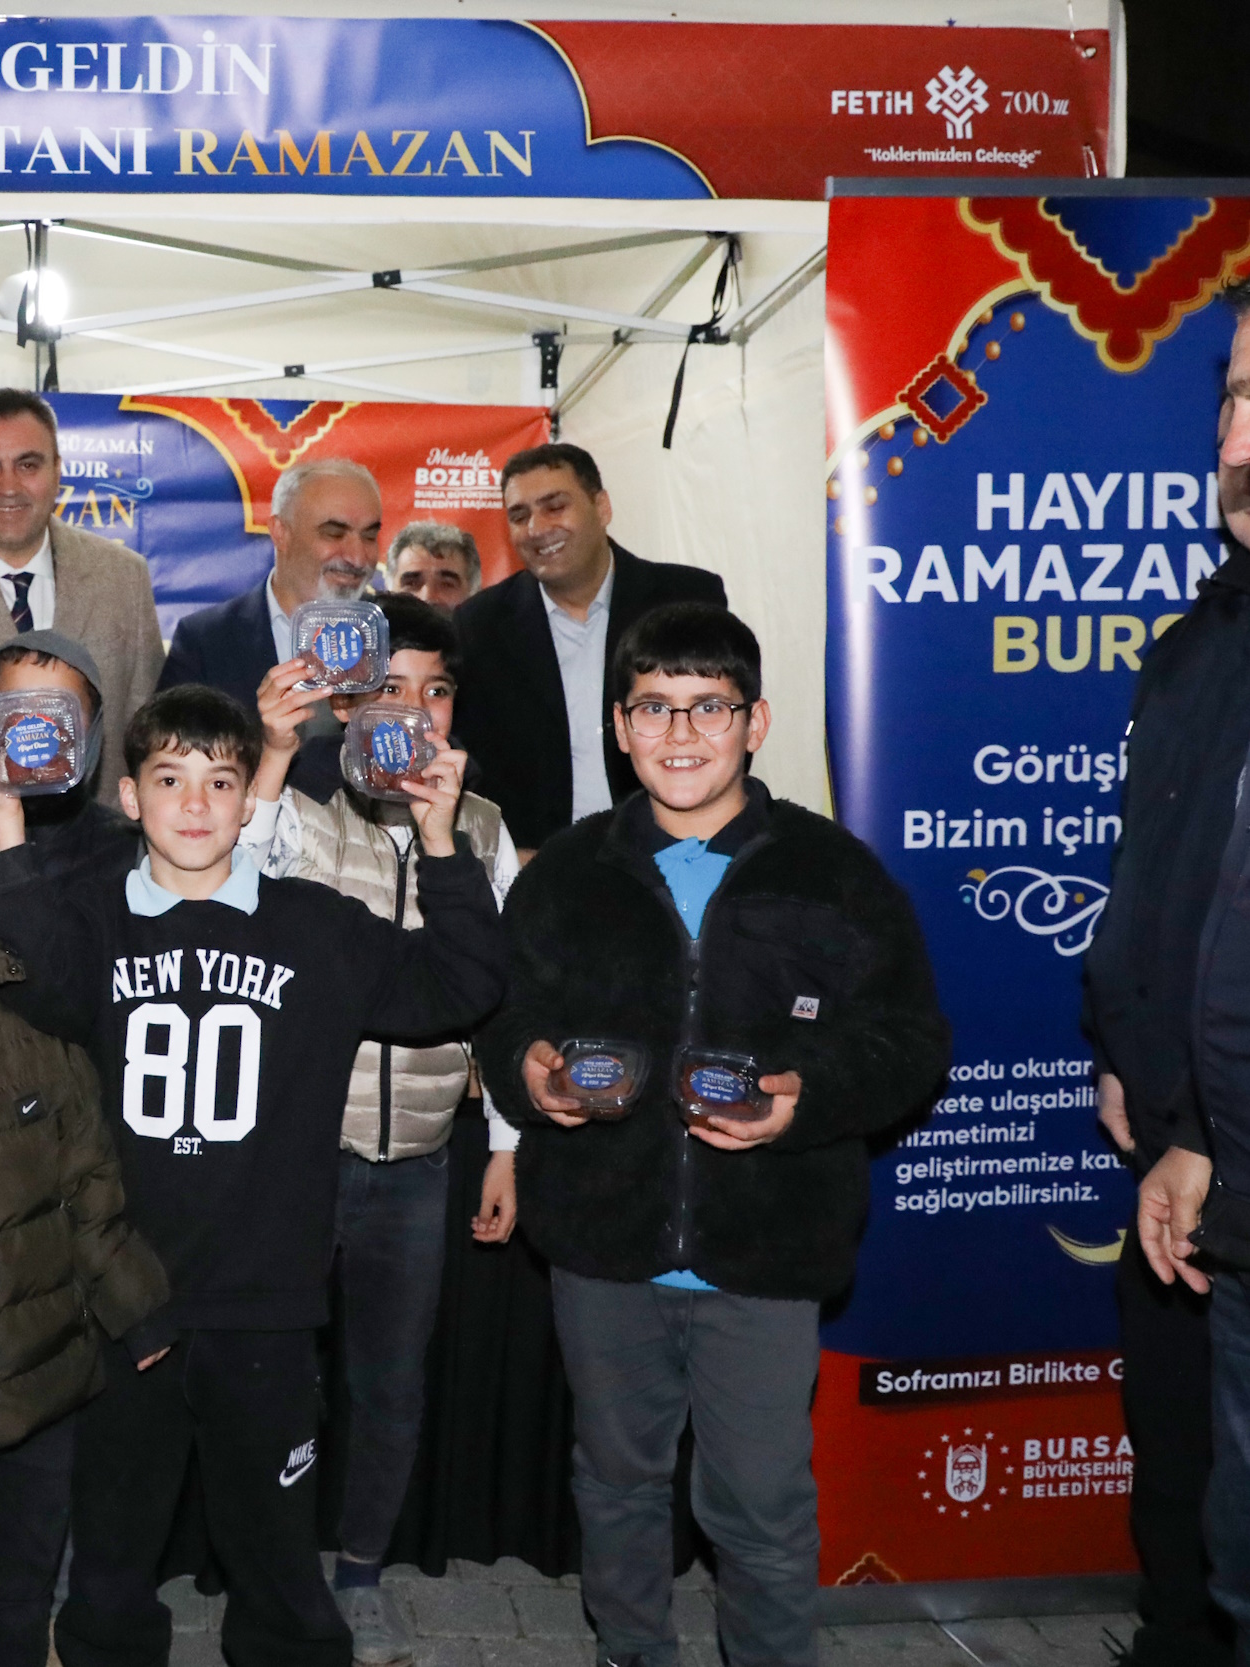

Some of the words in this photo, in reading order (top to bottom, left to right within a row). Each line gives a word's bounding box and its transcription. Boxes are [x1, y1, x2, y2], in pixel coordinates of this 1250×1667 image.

[0, 30, 277, 96] GELDİN
[173, 127, 537, 177] RAMAZAN
[426, 447, 491, 472] Mustafa
[415, 467, 503, 487] BOZBEY
[973, 741, 1128, 793] Görüşl
[903, 808, 1027, 849] Bizim
[1042, 806, 1123, 857] için
[112, 948, 184, 1004] NEW
[196, 948, 296, 1011] YORK
[122, 1002, 262, 1142] 80
[1011, 1057, 1094, 1078] okutar
[991, 1086, 1098, 1115] ulaşabili
[173, 1136, 203, 1155] EST.
[895, 1152, 1075, 1184] geliştirmemize
[894, 1181, 1100, 1215] sağlayabilirsiniz.
[876, 1369, 1000, 1393] Soframızı
[1009, 1361, 1101, 1385] Birlikte
[286, 1438, 315, 1469] NIKE
[1024, 1434, 1135, 1461] BURSA
[1022, 1475, 1133, 1498] BELEDİYESİ
